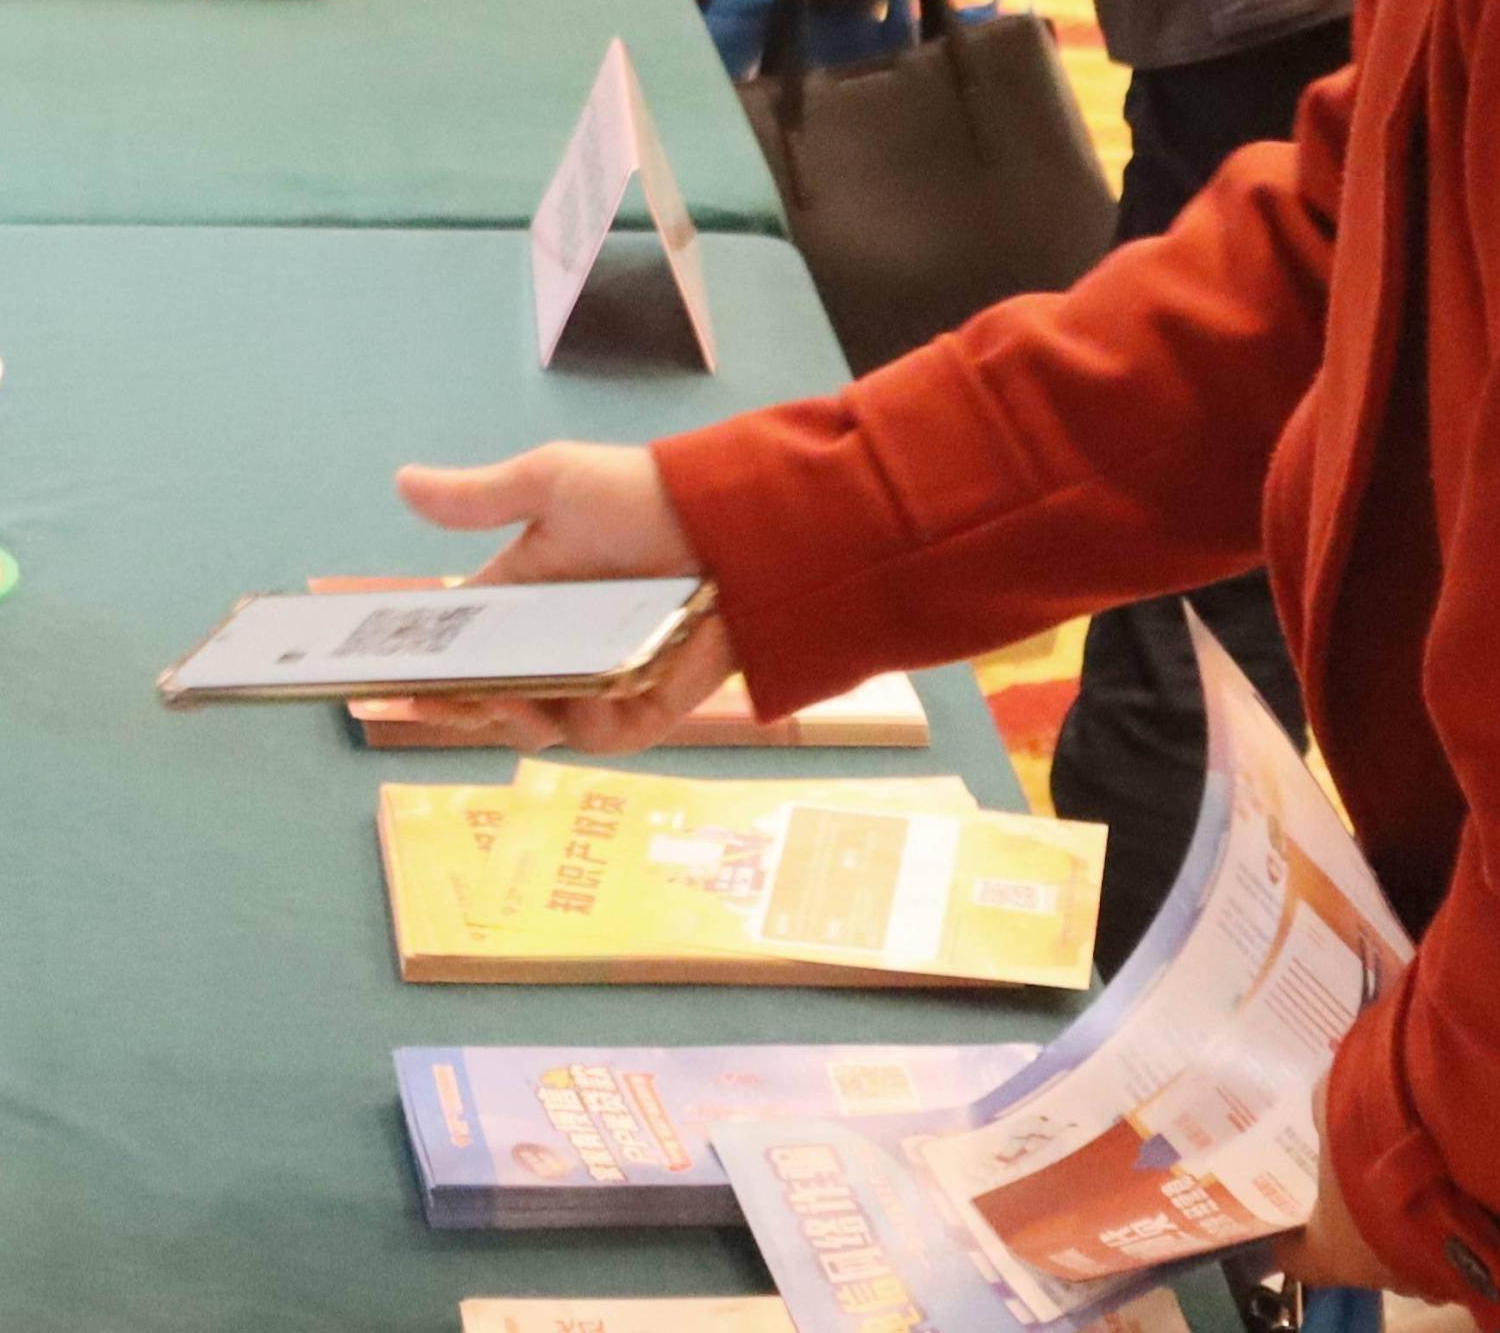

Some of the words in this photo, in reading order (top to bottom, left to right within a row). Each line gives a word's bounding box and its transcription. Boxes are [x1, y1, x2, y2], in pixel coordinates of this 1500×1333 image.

[545, 789, 627, 917] 知识产权贷
